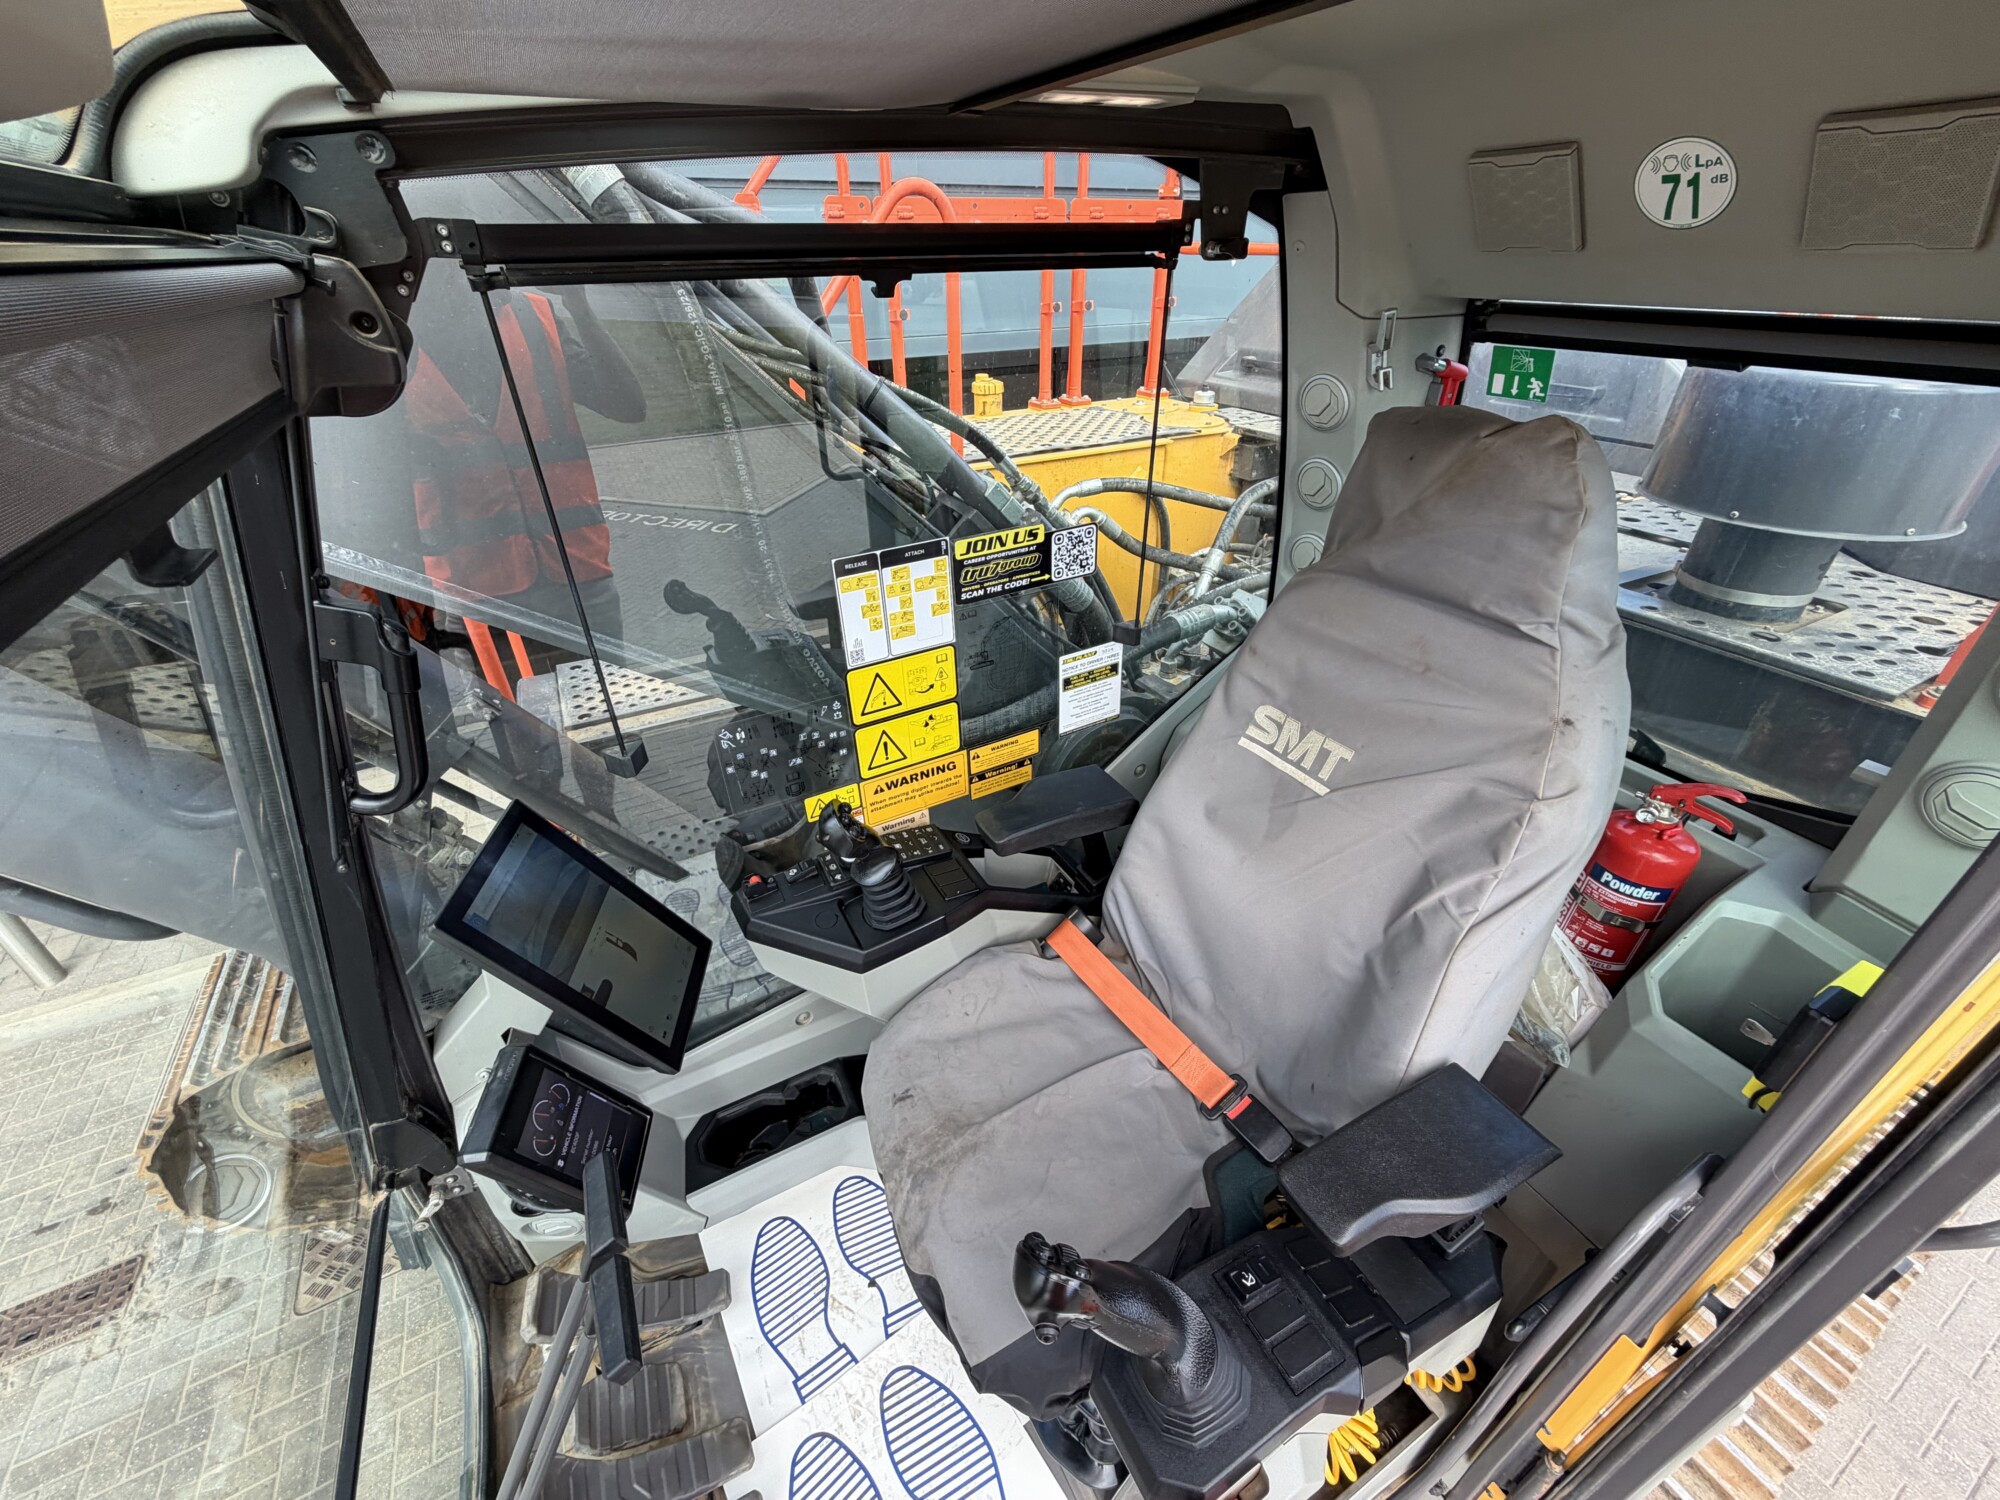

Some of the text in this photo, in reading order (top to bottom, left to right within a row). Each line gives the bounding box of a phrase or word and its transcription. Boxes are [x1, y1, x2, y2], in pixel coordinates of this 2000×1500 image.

[1695, 154, 1723, 169] LpA
[1710, 173, 1729, 184] dB
[1661, 171, 1701, 221] 71
[708, 362, 724, 395] MSHA
[738, 464, 749, 481] 380
[904, 549, 925, 557] ATTACH
[960, 533, 1009, 556] JOIN
[1013, 527, 1040, 545] US
[845, 560, 868, 570] RELEASE
[964, 556, 985, 565] CAREER
[986, 546, 1029, 560] OPPORTUNITIES
[962, 555, 1038, 583] tru7group
[961, 578, 1030, 600] SCAN THE CODE!
[984, 578, 1009, 587] OPERATORS
[803, 648, 830, 687] VOLVO
[991, 739, 1019, 751] WARNING
[1245, 704, 1355, 781] SMT
[885, 761, 957, 791] WARNING
[985, 763, 1018, 778] Warning!
[869, 798, 886, 807] When
[888, 791, 910, 800] moving
[911, 784, 929, 794] dipper
[930, 776, 952, 787] inwards
[870, 799, 903, 813] attachment
[918, 789, 933, 798] strike
[935, 780, 960, 792] machine!
[881, 816, 916, 832] Warning
[1600, 871, 1661, 900] Powder
[561, 1095, 583, 1156] VEHICLE INFORMATION
